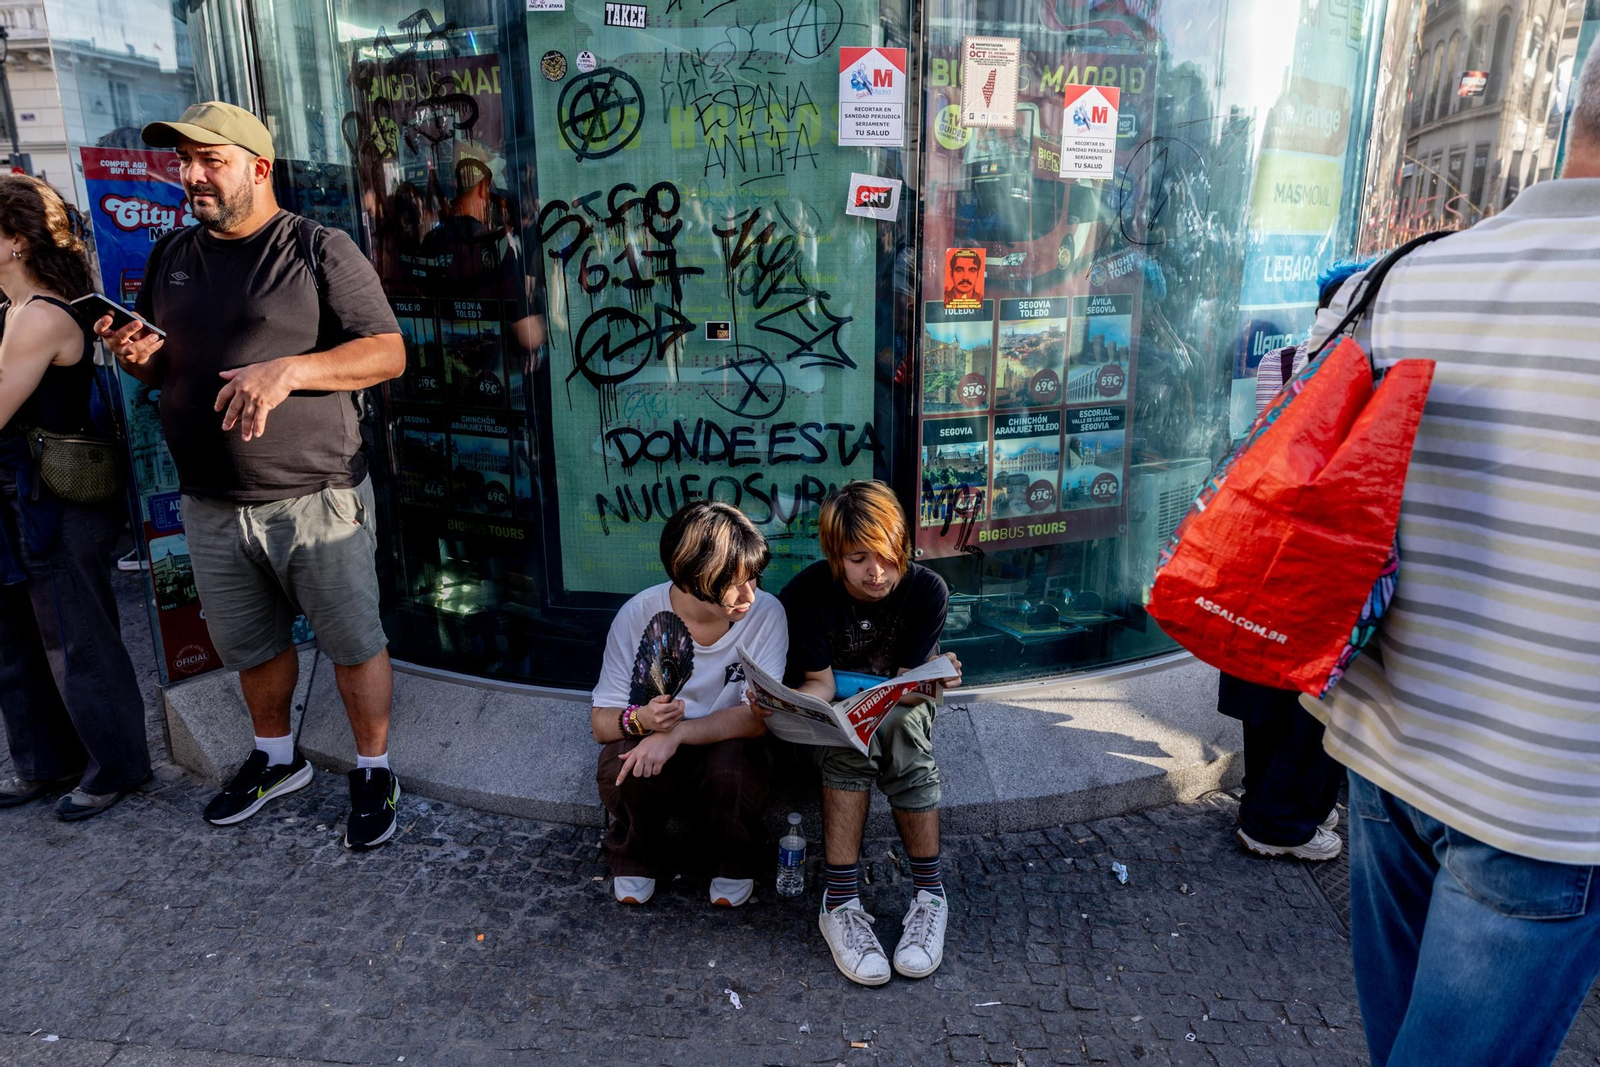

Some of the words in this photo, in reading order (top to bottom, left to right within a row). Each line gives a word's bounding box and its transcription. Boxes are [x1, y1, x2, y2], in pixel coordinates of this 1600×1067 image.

[606, 3, 646, 28] TAKEH
[1040, 64, 1146, 94] MADRID
[939, 124, 966, 138] GUIDED
[1038, 147, 1051, 160] BIG
[1038, 159, 1052, 171] BUS
[860, 190, 888, 204] CNT
[105, 198, 176, 231] City
[1107, 253, 1135, 271] NIGHT
[1109, 264, 1133, 279] TOUR
[1264, 255, 1318, 282] LEBARA
[1018, 300, 1051, 309] SEGOVIA
[1087, 306, 1116, 314] SEGOVIA
[1020, 309, 1049, 317] TOLEDO
[1034, 381, 1054, 392] 69€
[1101, 375, 1120, 386] 59€
[962, 385, 982, 396] 39€
[1079, 408, 1112, 418] ESCORIAL
[461, 415, 496, 425] CHINCHÓN
[1008, 414, 1048, 426] CHINCHÓN
[451, 422, 482, 432] ARANJUEZ
[484, 424, 508, 434] TOLEDO
[940, 427, 972, 436] SEGOVIA
[995, 425, 1032, 435] ARANJUEZ
[1034, 423, 1059, 432] TOLEDO
[1080, 422, 1110, 432] SEGOVIA
[1093, 482, 1117, 495] 69€
[488, 491, 504, 502] 69€
[1030, 490, 1050, 501] 69€
[489, 525, 524, 540] TOURS
[979, 526, 1024, 542] BIGBUS
[1027, 521, 1066, 536] TOURS
[1194, 596, 1287, 645] ASSAI.COM.BR
[176, 653, 207, 667] OFICIAL
